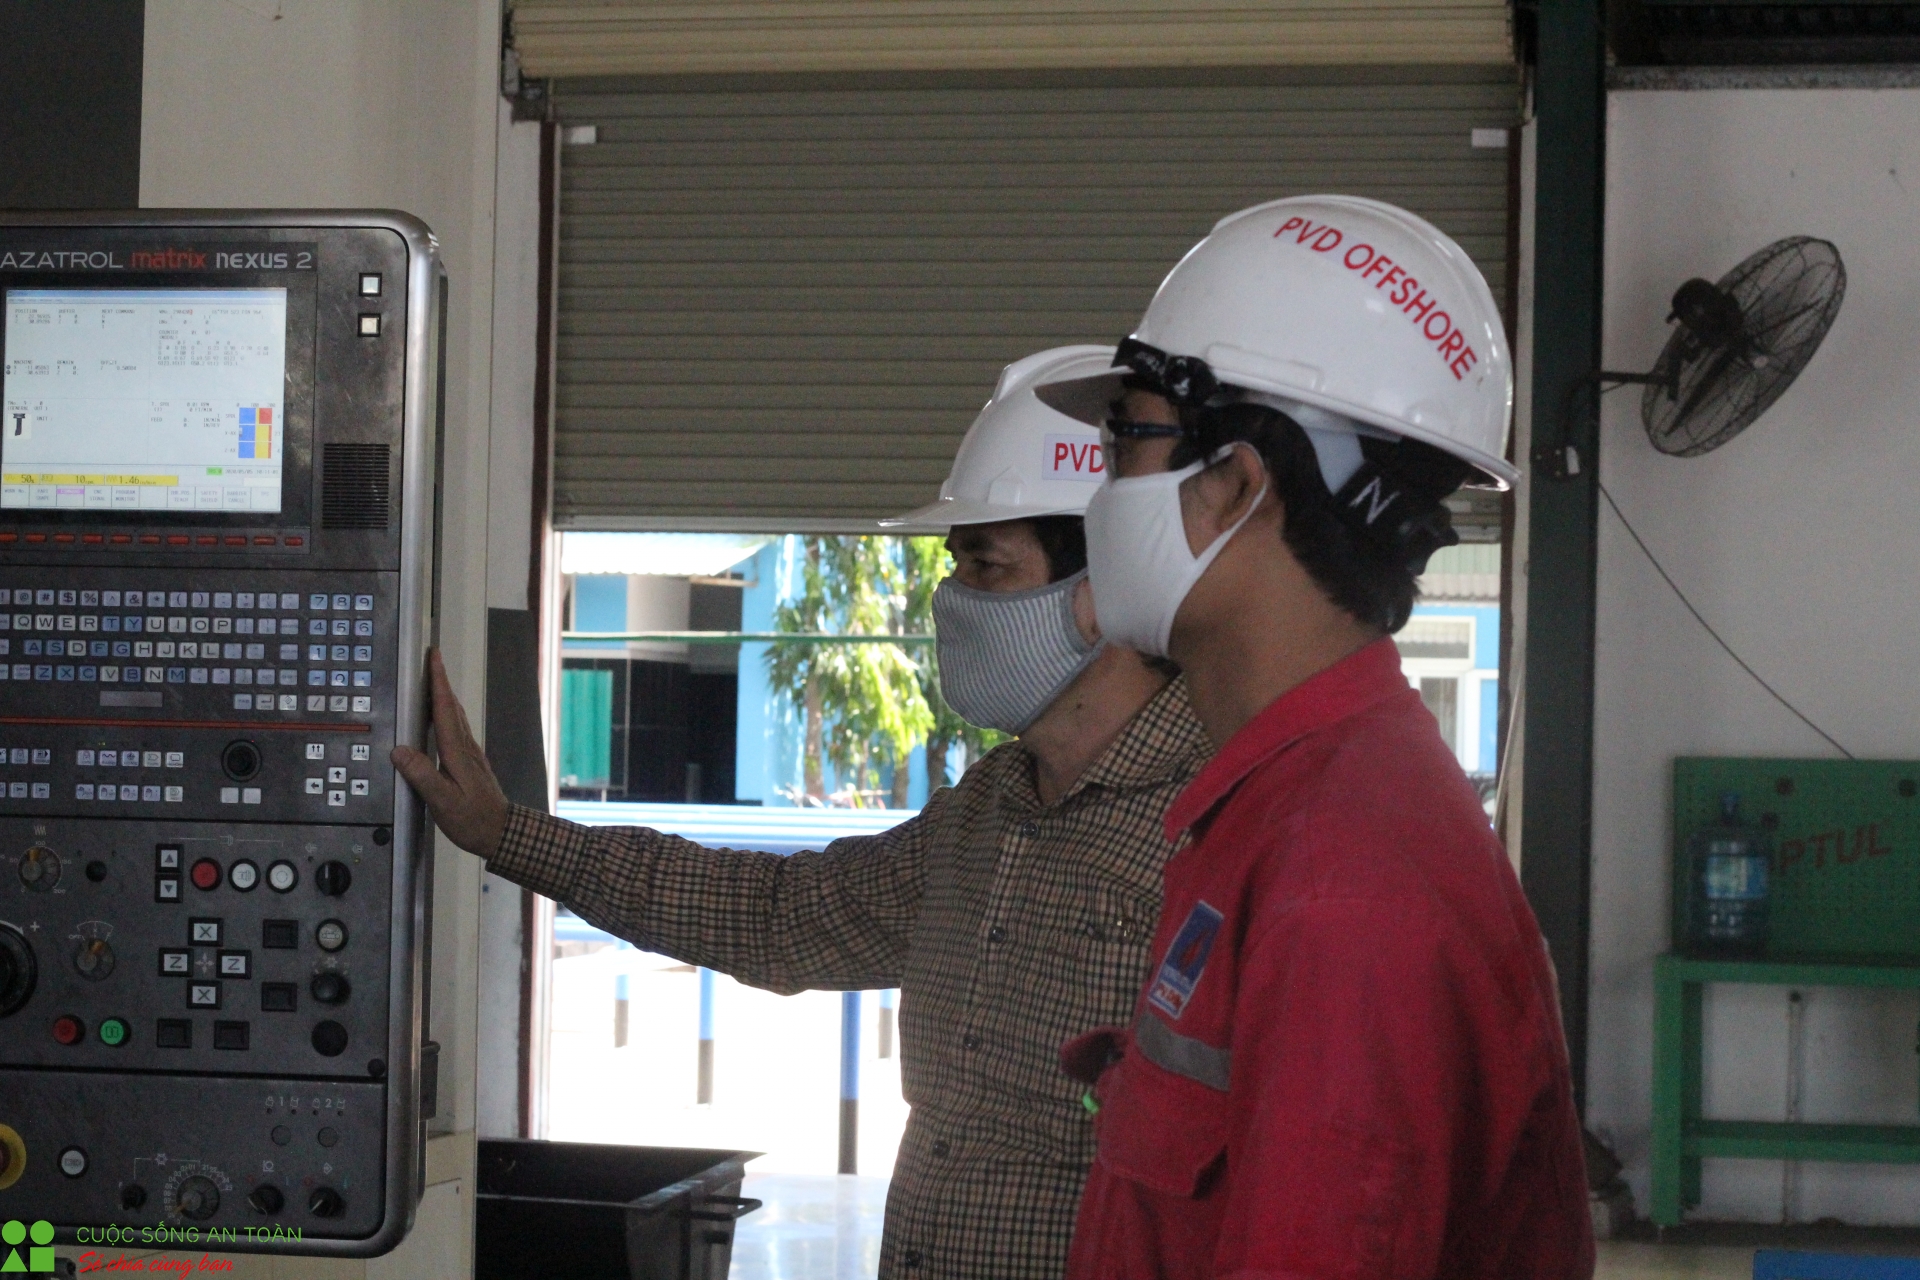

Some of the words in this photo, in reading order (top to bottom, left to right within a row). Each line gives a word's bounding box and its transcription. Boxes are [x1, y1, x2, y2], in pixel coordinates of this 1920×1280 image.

[296, 252, 312, 269] 2
[1273, 217, 1343, 252] PVD
[1343, 243, 1478, 381] OFFSHORE
[1053, 442, 1105, 474] PVD
[315, 596, 324, 606] 7
[337, 597, 347, 607] 8
[359, 598, 370, 608] 9
[18, 615, 30, 627] Q
[39, 617, 53, 628] W
[62, 618, 72, 628] E
[85, 618, 95, 628] R
[109, 618, 118, 629] T
[129, 618, 139, 629] Y
[151, 620, 162, 630] U
[217, 621, 229, 631] P
[314, 621, 324, 632] 4
[337, 622, 347, 633] 5
[359, 622, 369, 633] 6
[28, 642, 39, 652] A
[51, 642, 61, 652] S
[72, 643, 84, 653] D
[95, 643, 105, 653] F
[116, 644, 128, 654] G
[139, 644, 150, 654] H
[162, 644, 172, 655] J
[183, 645, 194, 656] K
[206, 645, 215, 655] L
[336, 647, 346, 658] 2
[359, 648, 368, 659] 3
[39, 667, 50, 678] Z
[61, 667, 72, 678] X
[83, 667, 94, 679] C
[105, 669, 116, 679] V
[127, 668, 138, 679] B
[150, 669, 161, 680] N
[170, 669, 184, 680] M
[200, 925, 212, 939] X
[169, 956, 182, 969] Z
[227, 958, 240, 971] Z
[198, 988, 211, 1001] X
